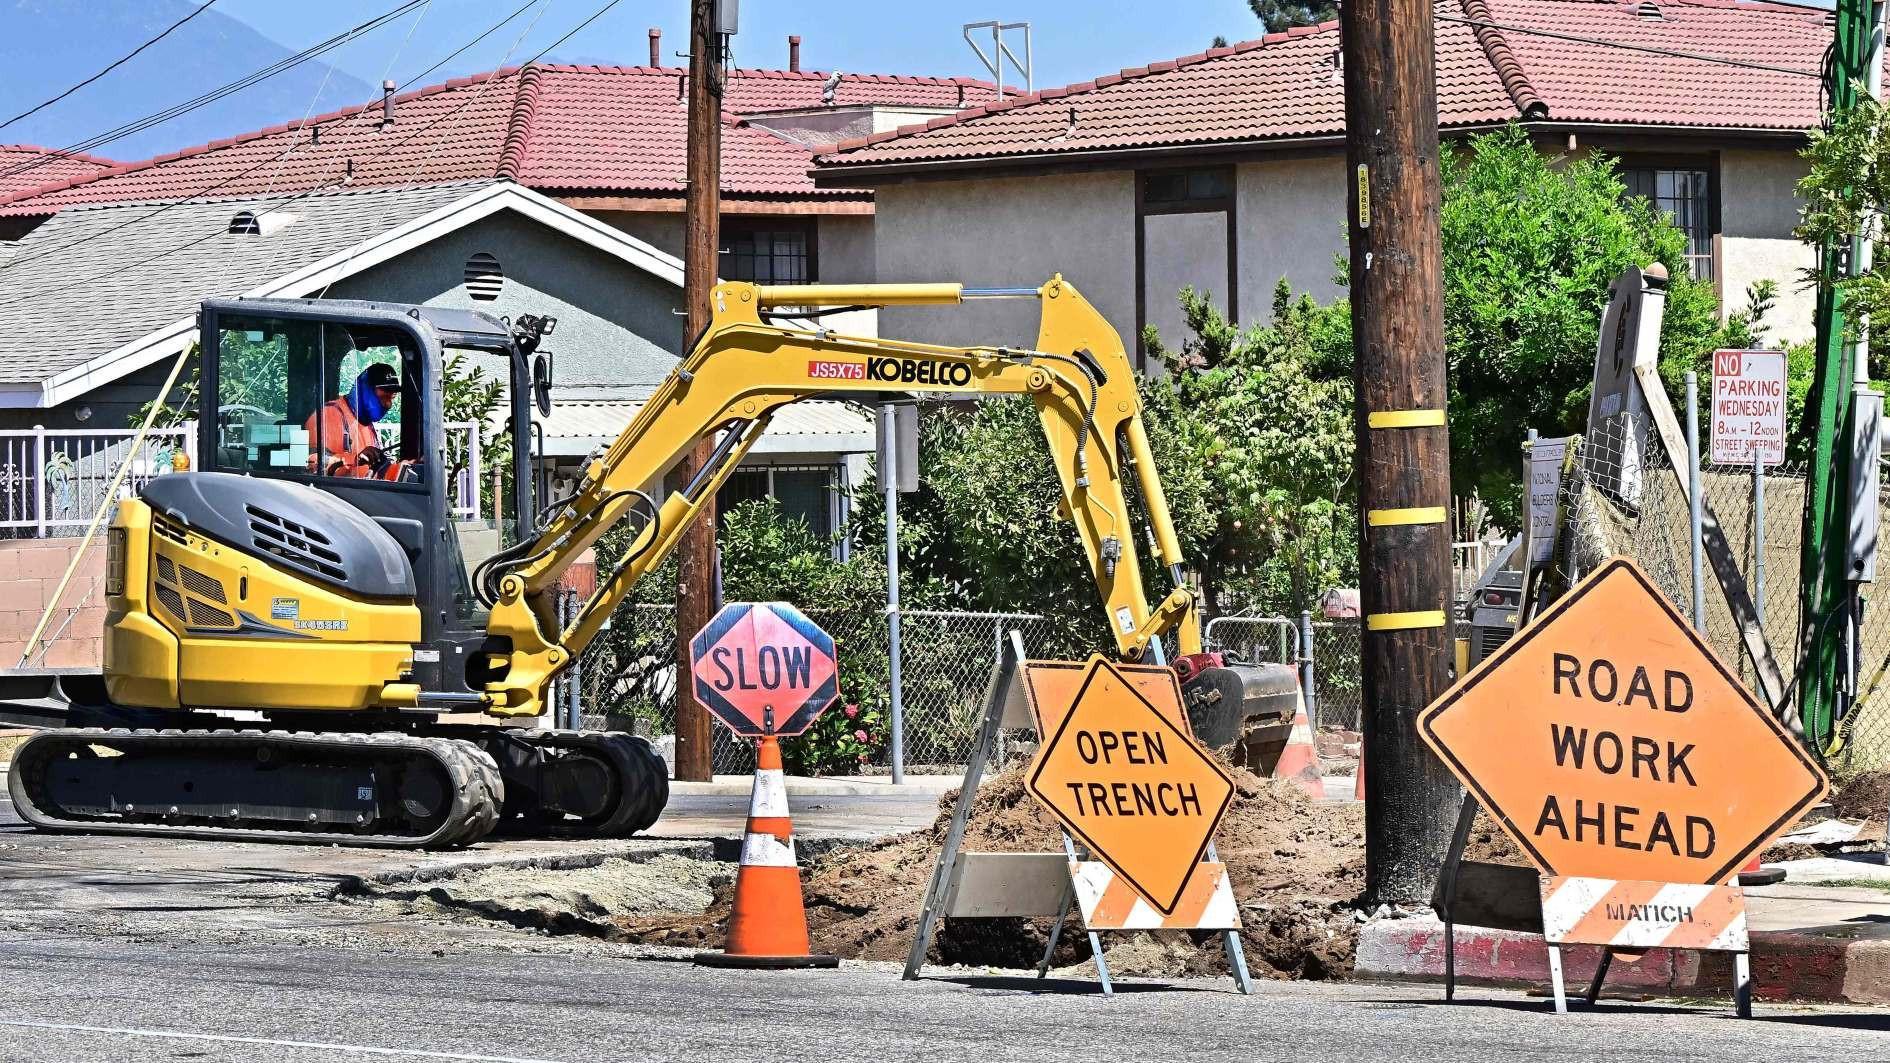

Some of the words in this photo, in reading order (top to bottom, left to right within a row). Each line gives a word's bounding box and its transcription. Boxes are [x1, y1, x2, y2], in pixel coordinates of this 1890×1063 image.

[811, 362, 864, 380] JS5X75
[867, 356, 972, 387] KOBELCO
[1718, 355, 1739, 375] NO
[1719, 380, 1780, 397] PARKING
[1719, 400, 1780, 417] WEDNESDAY
[1715, 438, 1743, 451] STREET
[1745, 439, 1780, 452] SWEEPING
[712, 645, 812, 692] SLOW
[1553, 652, 1694, 714] ROAD
[1076, 730, 1168, 765] OPEN
[1550, 723, 1698, 788] WORK
[1066, 782, 1202, 817] TRENCH
[1534, 794, 1717, 860] AHEAD
[1606, 902, 1695, 924] MATICH
